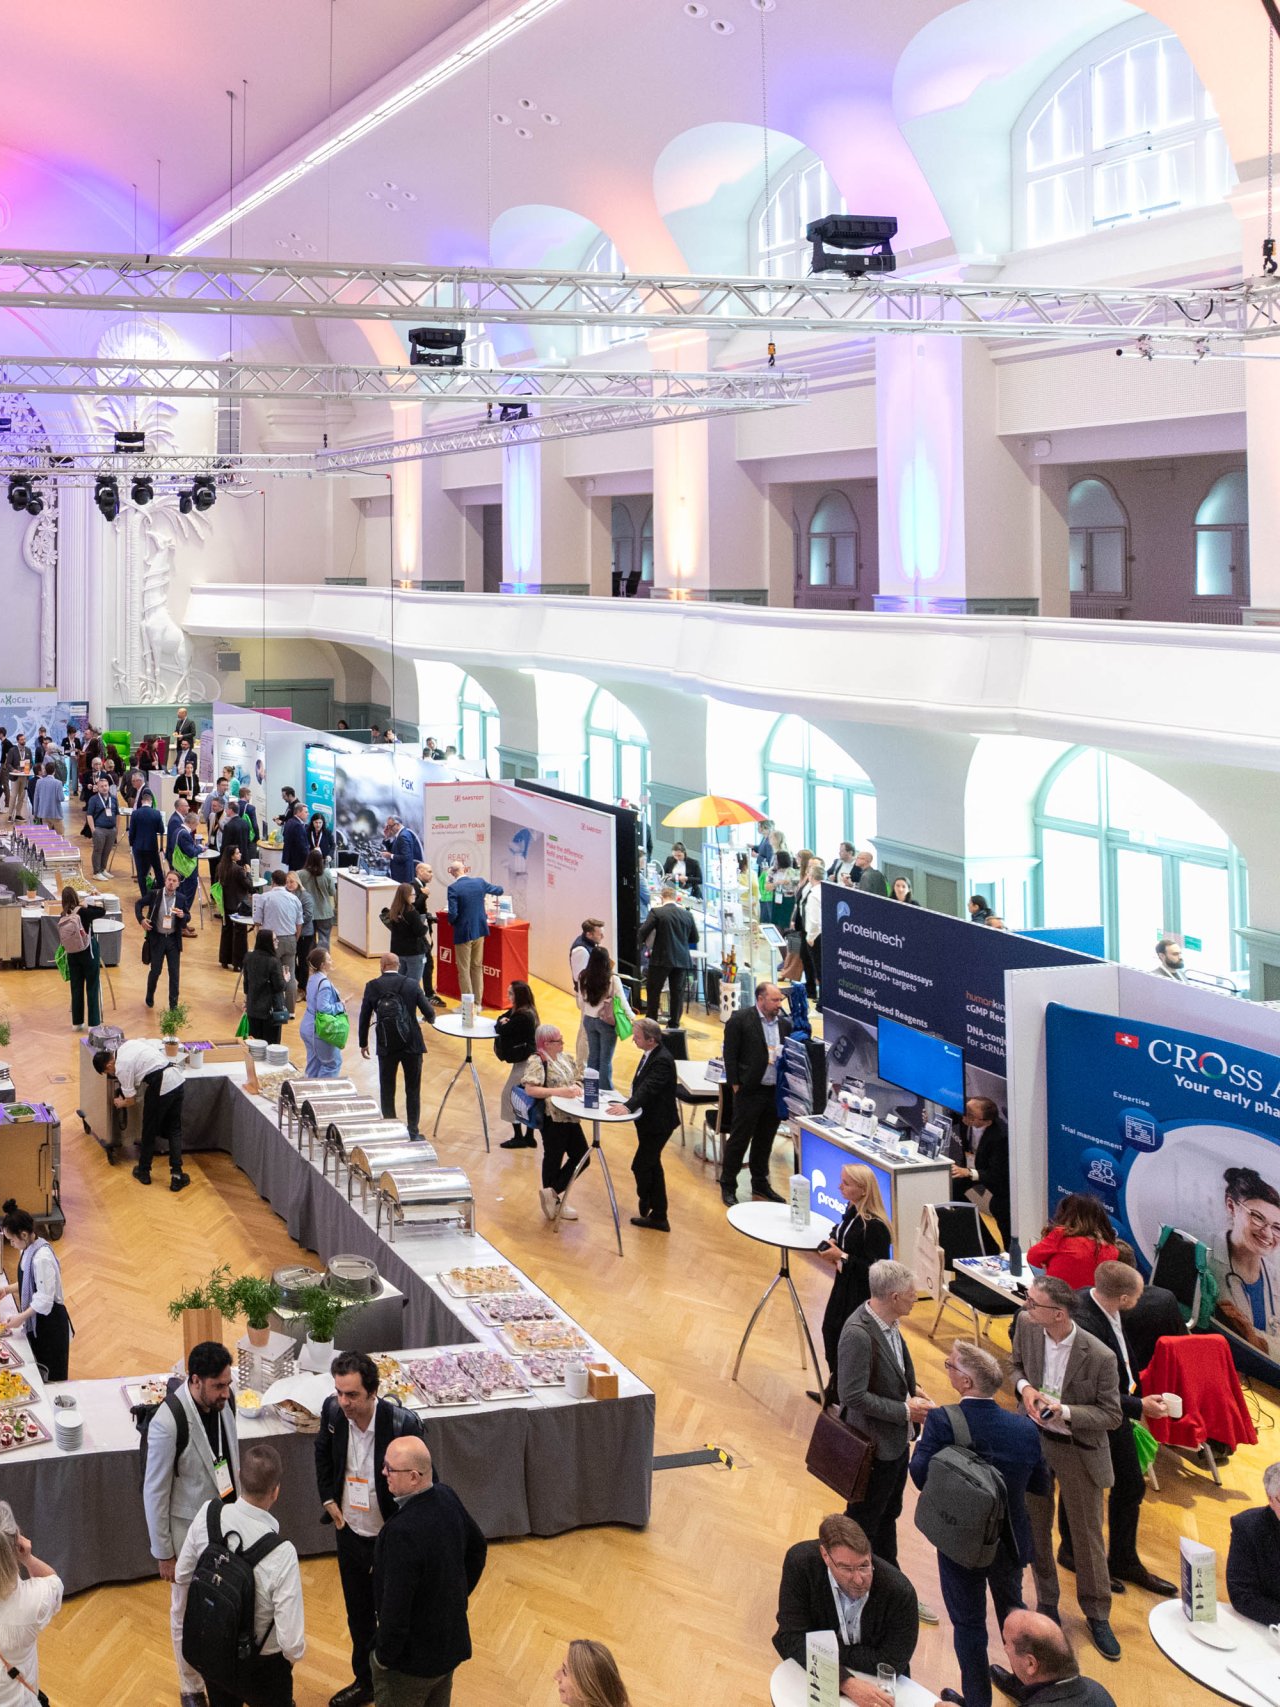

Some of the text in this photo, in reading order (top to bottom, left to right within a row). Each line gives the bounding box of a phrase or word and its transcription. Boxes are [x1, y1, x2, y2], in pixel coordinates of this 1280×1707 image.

[401, 778, 414, 791] FGK
[838, 947, 933, 987] Antibodies & Immunoassays
[838, 958, 917, 992] Against 13,000+ targets
[838, 988, 928, 1028] Nanobody-based Reagents
[966, 1004, 1006, 1024] cGMP Rec
[966, 1036, 979, 1047] for
[1148, 1039, 1263, 1092] CROSS
[1113, 1091, 1150, 1107] Expertise
[1174, 1073, 1210, 1094] Your
[1213, 1088, 1251, 1109] early
[1060, 1123, 1122, 1151] Trial management
[817, 1191, 848, 1215] prote
